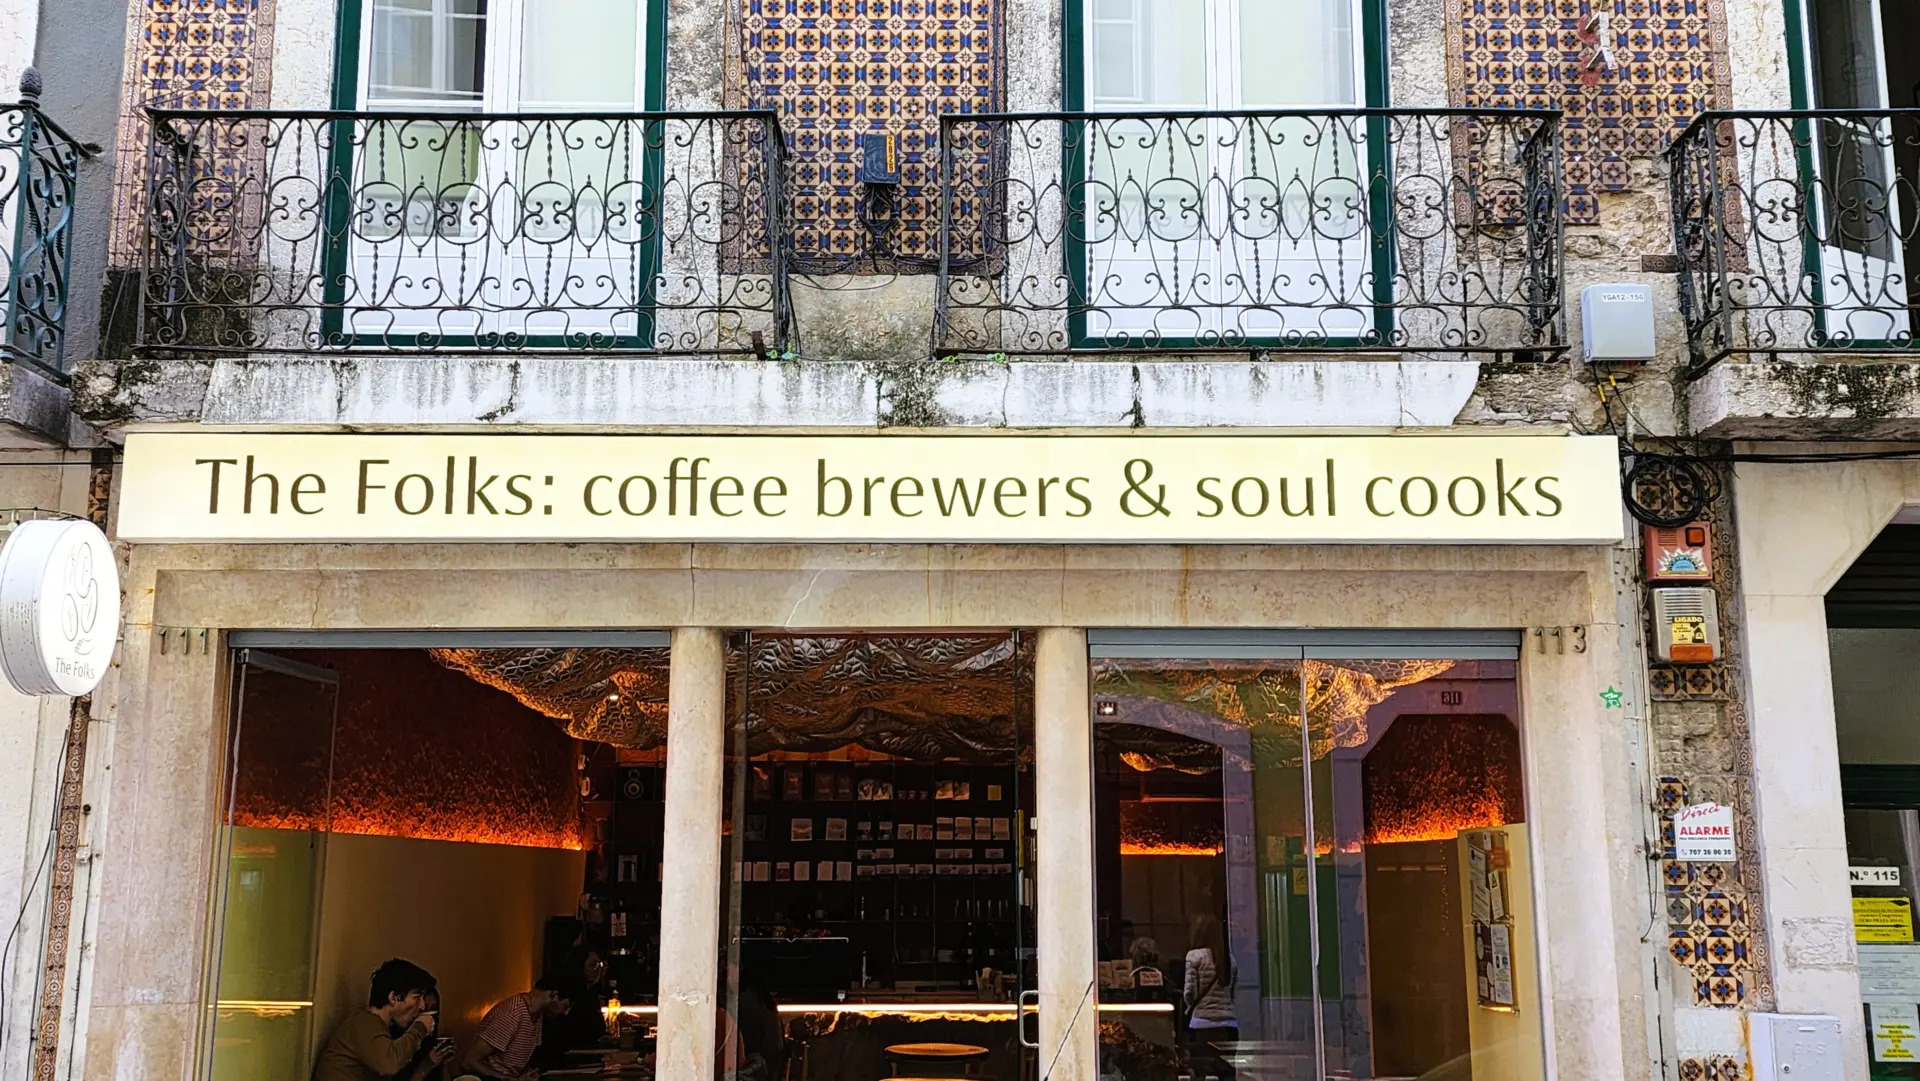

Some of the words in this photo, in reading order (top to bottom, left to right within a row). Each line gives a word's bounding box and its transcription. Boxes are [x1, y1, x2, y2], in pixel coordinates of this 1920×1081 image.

[195, 455, 326, 516] The
[357, 455, 554, 517] Folks:
[583, 457, 788, 518] coffee
[817, 458, 1092, 518] brewers
[1119, 458, 1171, 518] &
[1196, 458, 1336, 518] soul
[1365, 458, 1562, 518] cooks
[159, 626, 209, 655] 111
[1534, 624, 1587, 654] 113
[55, 656, 72, 676] The
[73, 661, 96, 680] Folks
[1680, 826, 1730, 836] ALARME
[1873, 870, 1898, 881] 115
